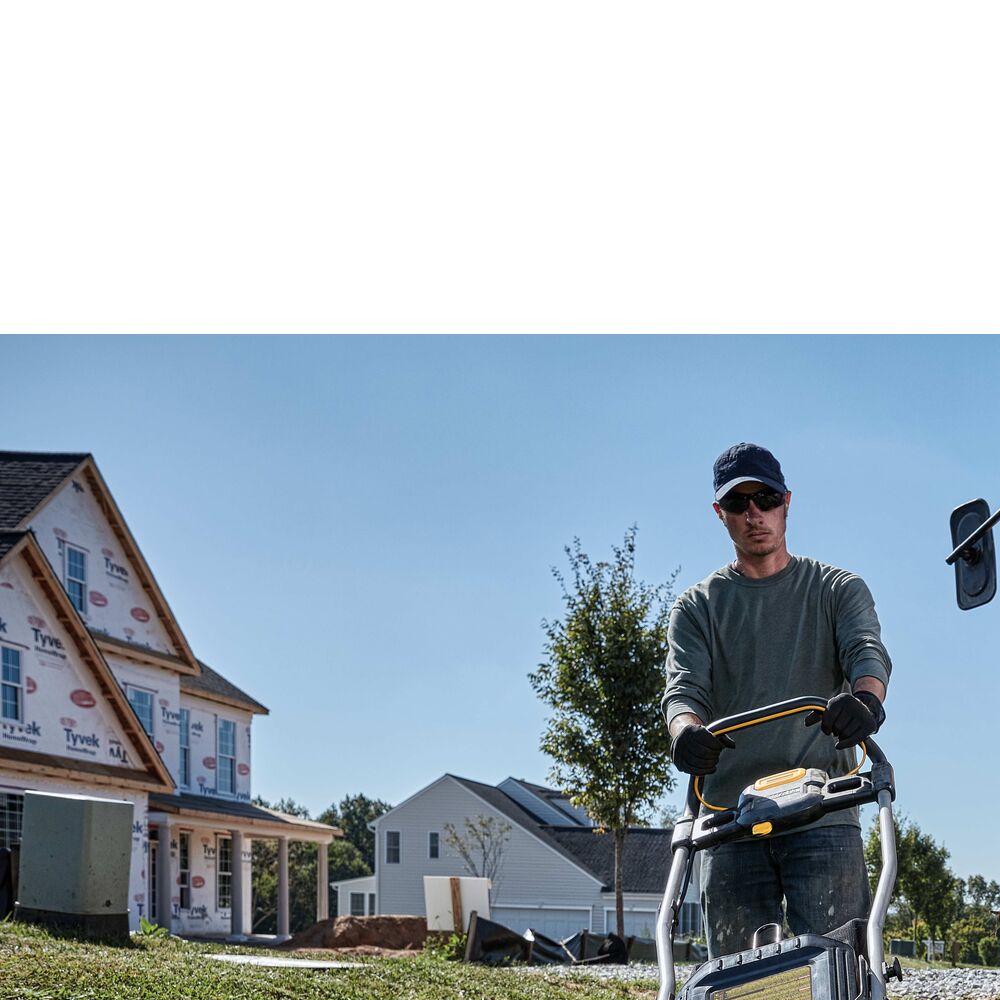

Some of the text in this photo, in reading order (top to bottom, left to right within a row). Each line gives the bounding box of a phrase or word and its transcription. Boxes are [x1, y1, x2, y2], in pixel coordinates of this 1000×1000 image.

[104, 557, 129, 577] Tyve
[31, 627, 65, 650] Tyve
[64, 728, 101, 749] Tyvek
